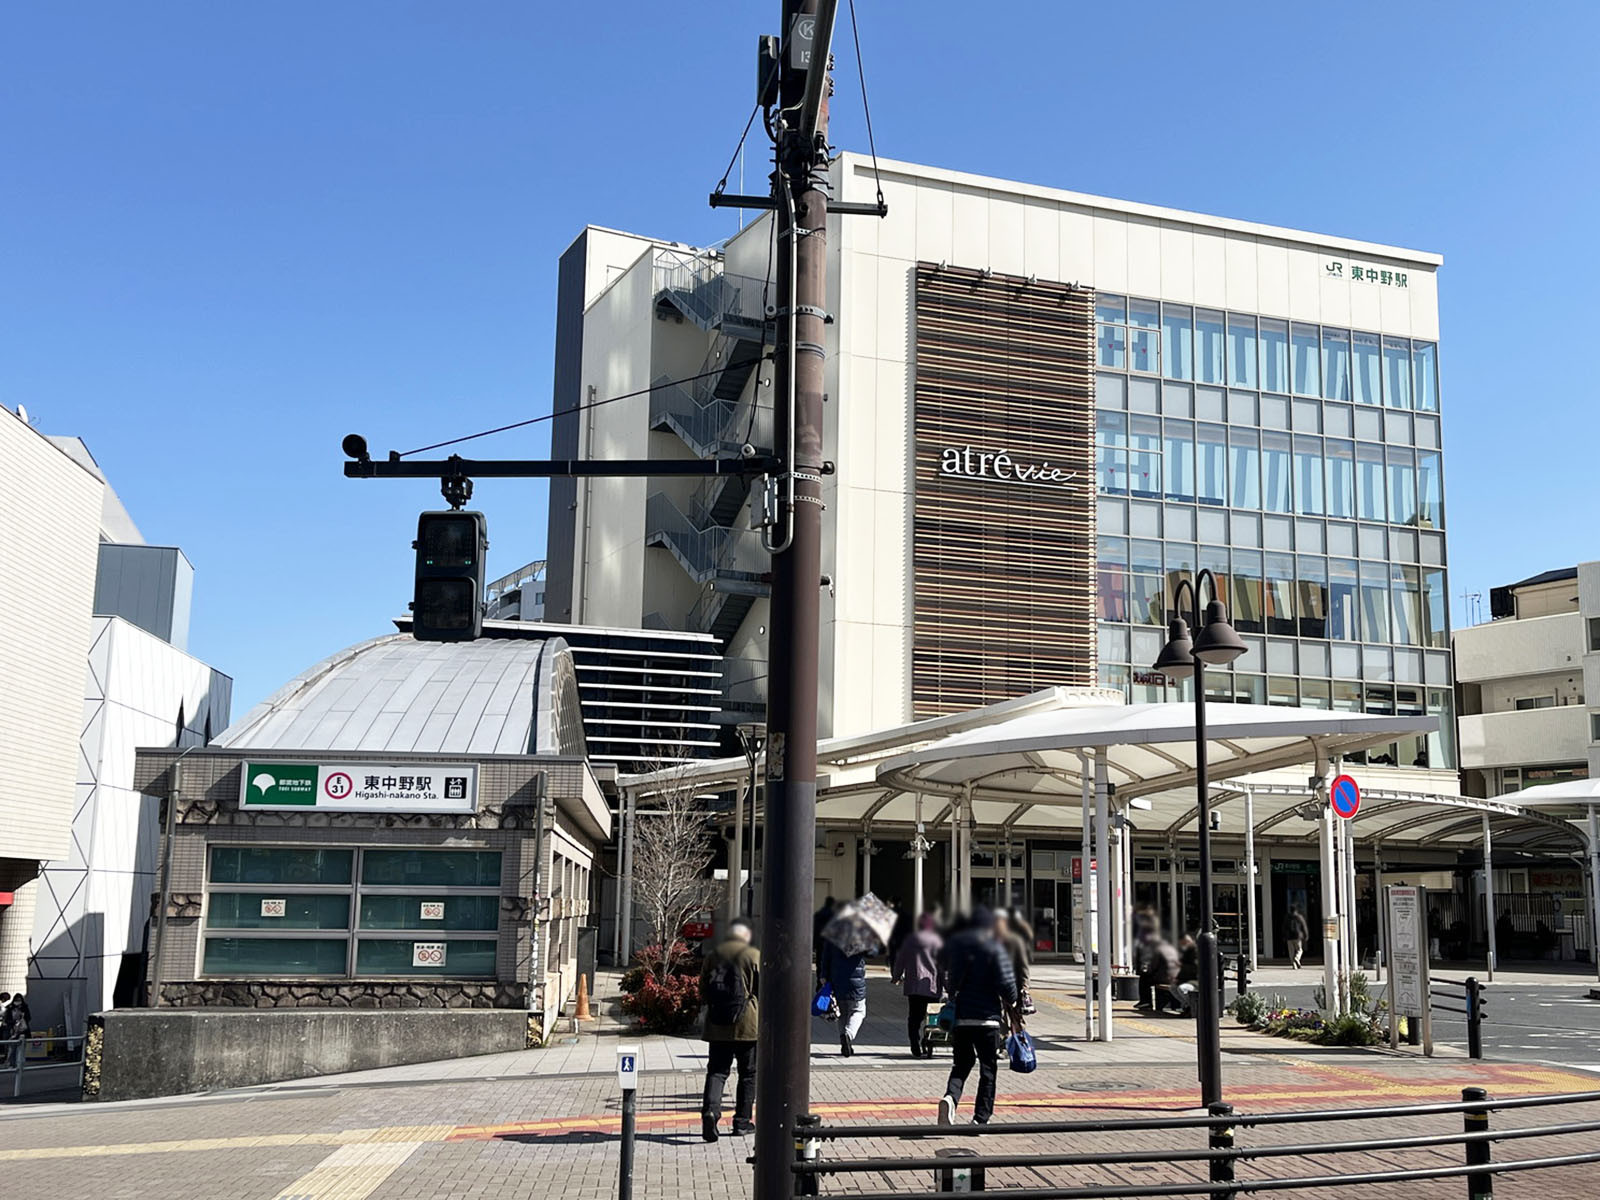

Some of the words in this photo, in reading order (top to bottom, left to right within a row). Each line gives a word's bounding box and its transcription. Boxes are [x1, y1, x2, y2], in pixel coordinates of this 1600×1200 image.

[1326, 262, 1343, 273] JR
[1351, 265, 1408, 288] 東中野駅
[941, 445, 1012, 479] atré
[336, 776, 342, 785] E
[364, 775, 432, 791] 東中野駅
[331, 785, 344, 793] 31
[355, 791, 421, 800] Higashi-nakano
[423, 791, 440, 800] Sta.
